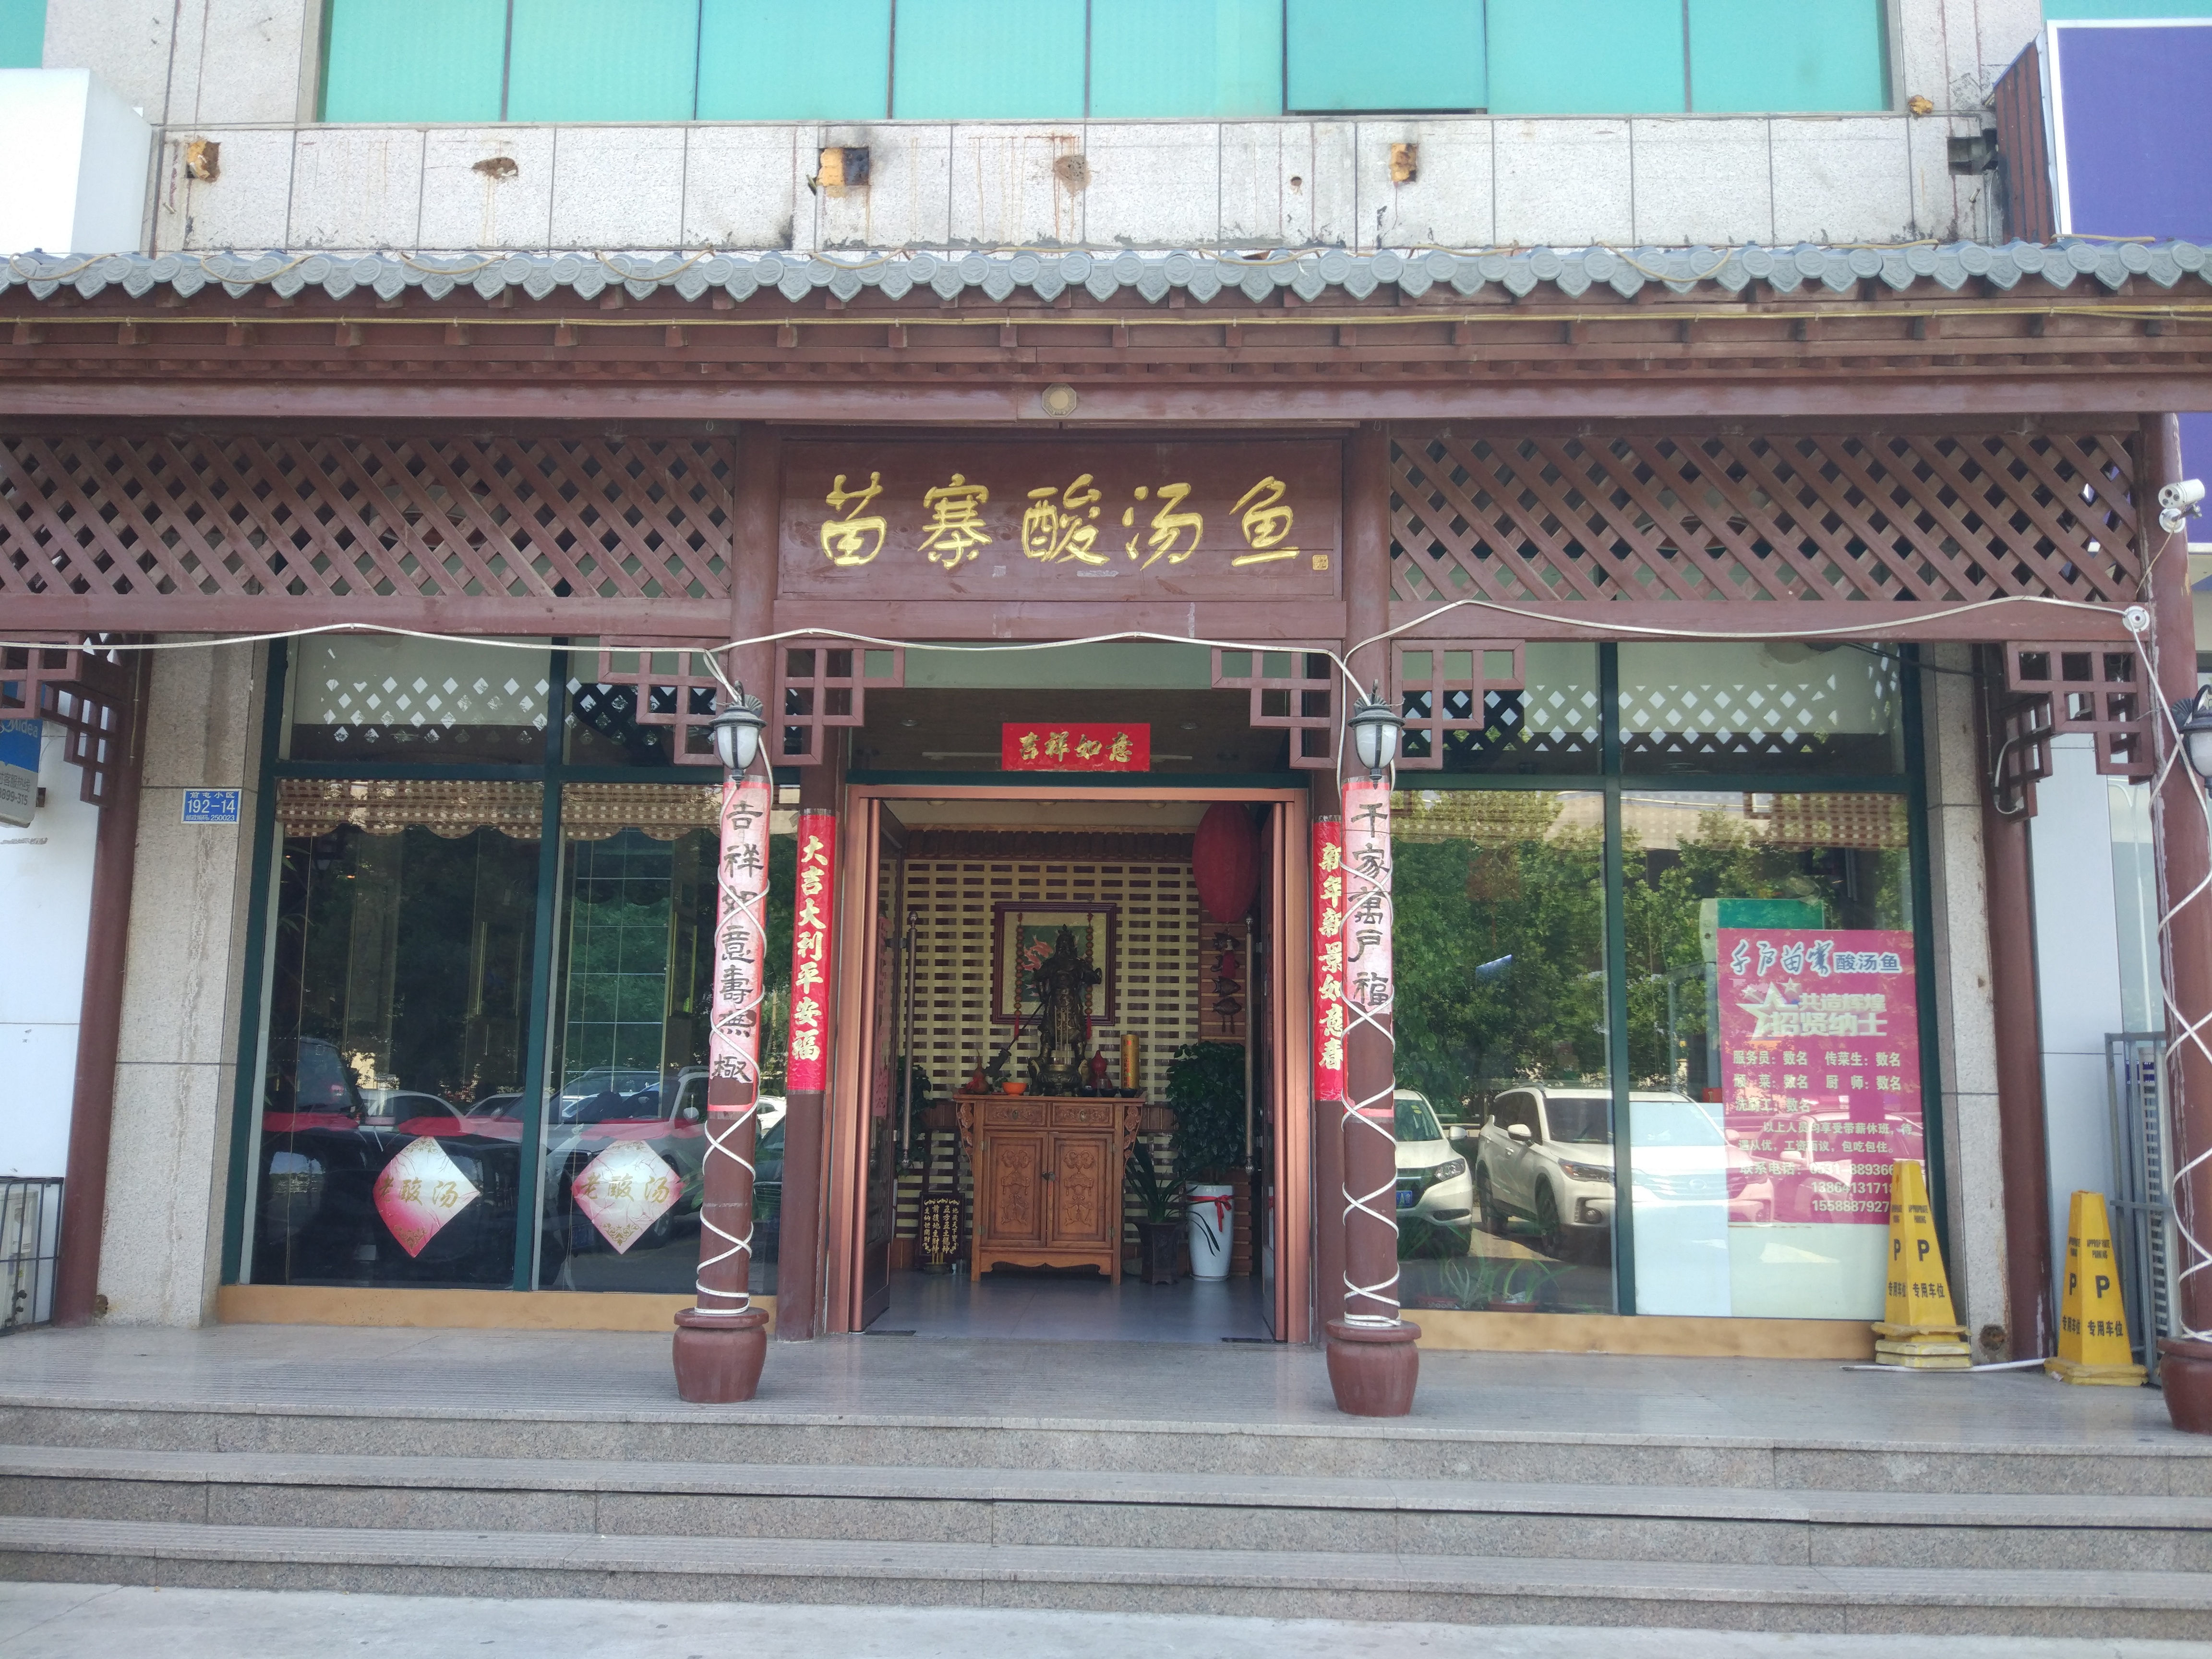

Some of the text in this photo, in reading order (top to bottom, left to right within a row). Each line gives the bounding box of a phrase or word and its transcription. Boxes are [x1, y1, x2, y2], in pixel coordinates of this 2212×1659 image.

[820, 472, 1299, 571] 苗寨酸汤鱼
[1019, 731, 1133, 762] 吉祥如意
[187, 799, 235, 813] 192-14
[792, 835, 828, 1062] 大吉大利平安福
[1799, 993, 1887, 1011] 共造辉煌
[1771, 1011, 1887, 1036] 招贤纳士
[379, 1174, 459, 1208] 老酸汤
[580, 1173, 670, 1203] 老酸汤
[1812, 1182, 1892, 1194] 1386413171
[1813, 1200, 1889, 1213] 1558887927
[1894, 1238, 1901, 1261] P
[1917, 1239, 1930, 1262] P
[1888, 1281, 1906, 1297] 专用车位
[1912, 1282, 1945, 1298] 专用车位
[2069, 1273, 2077, 1296] P
[2095, 1275, 2110, 1298] P
[2062, 1315, 2081, 1335] 专用车位
[2087, 1321, 2124, 1337] 专用车位
